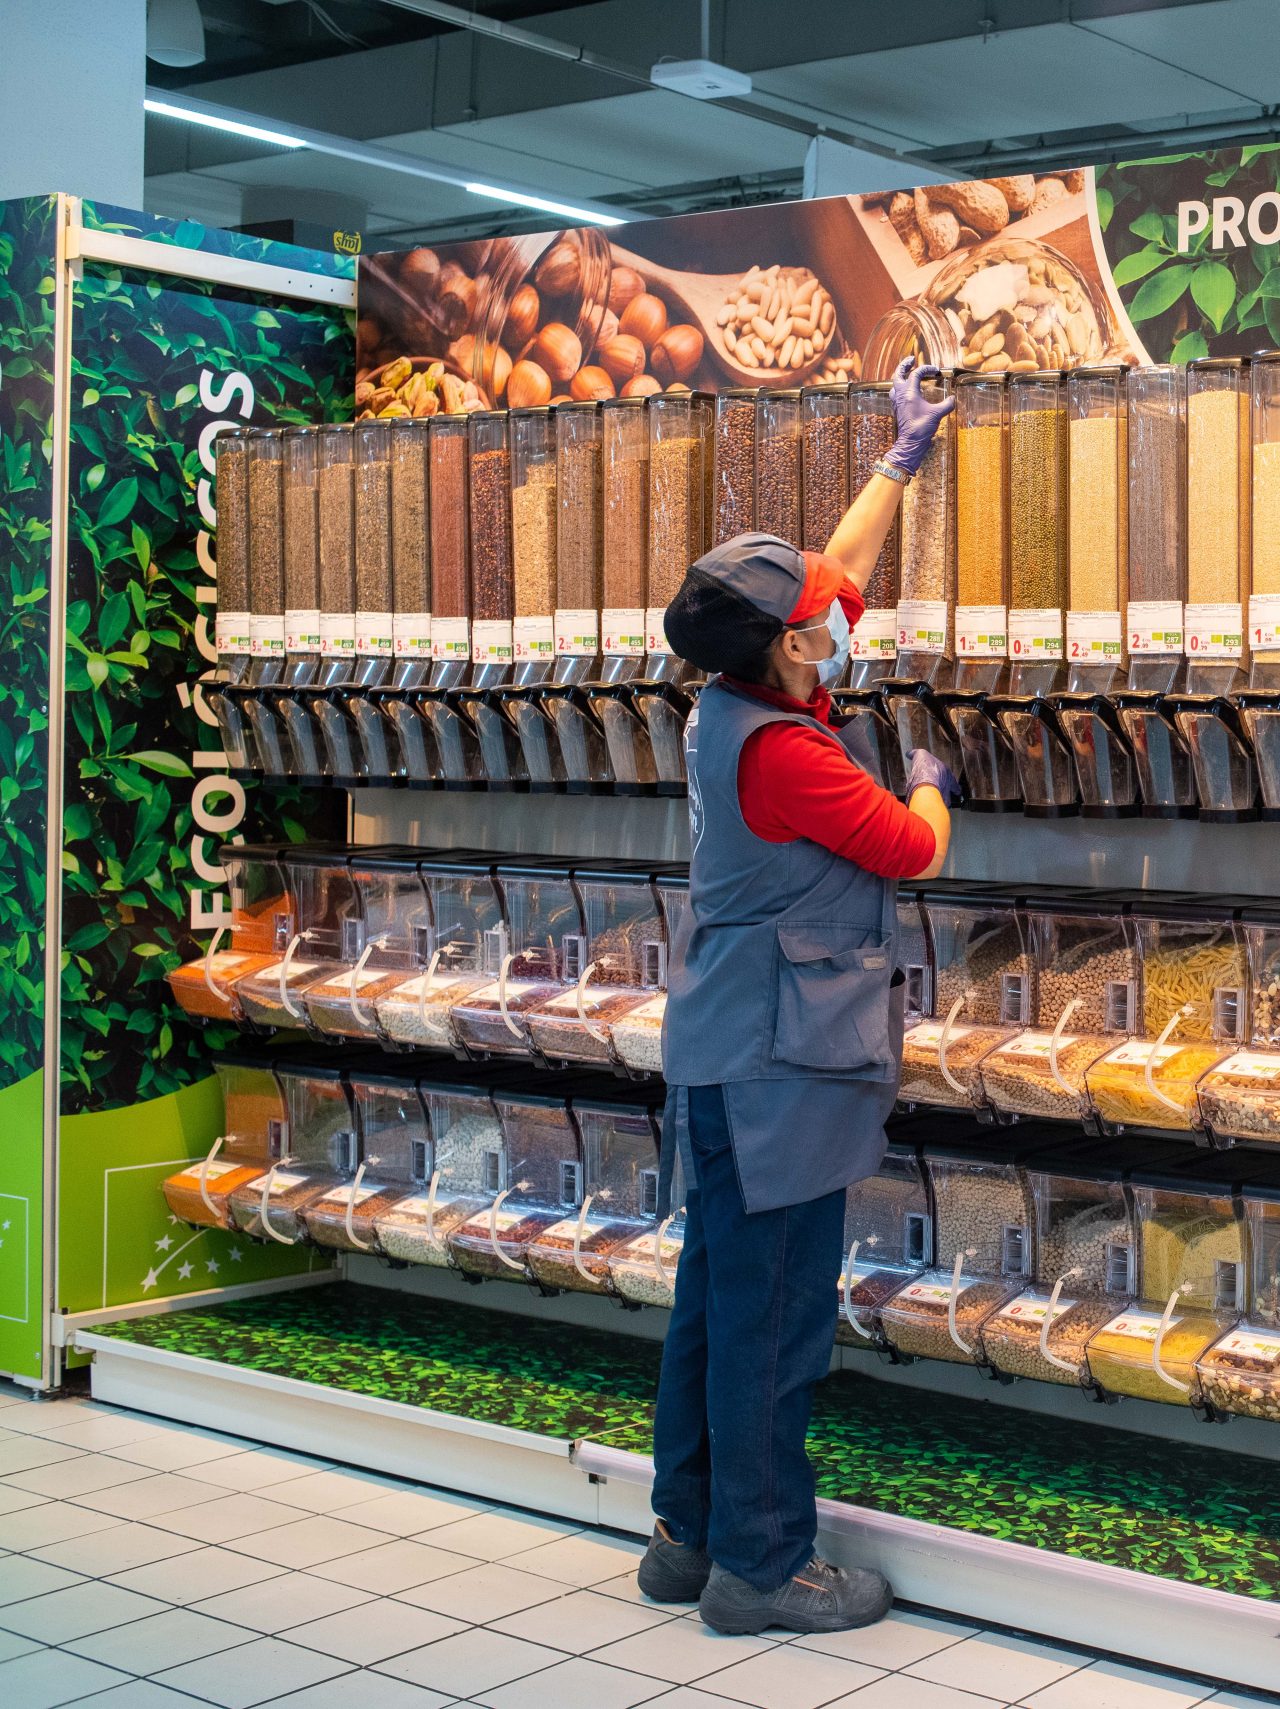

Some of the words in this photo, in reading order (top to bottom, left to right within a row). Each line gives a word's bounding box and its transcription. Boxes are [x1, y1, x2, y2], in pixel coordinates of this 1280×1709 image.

[650, 637, 655, 648] 3
[900, 631, 906, 644] 3
[1132, 634, 1140, 648] 2
[1255, 629, 1261, 643] 1
[516, 644, 521, 655] 3
[559, 638, 564, 649] 2
[605, 637, 611, 649] 4
[853, 641, 859, 654] 2
[960, 637, 966, 650] 1
[1014, 640, 1021, 654] 0
[1191, 636, 1198, 650] 0
[475, 648, 480, 659] 3
[1072, 643, 1079, 657] 2
